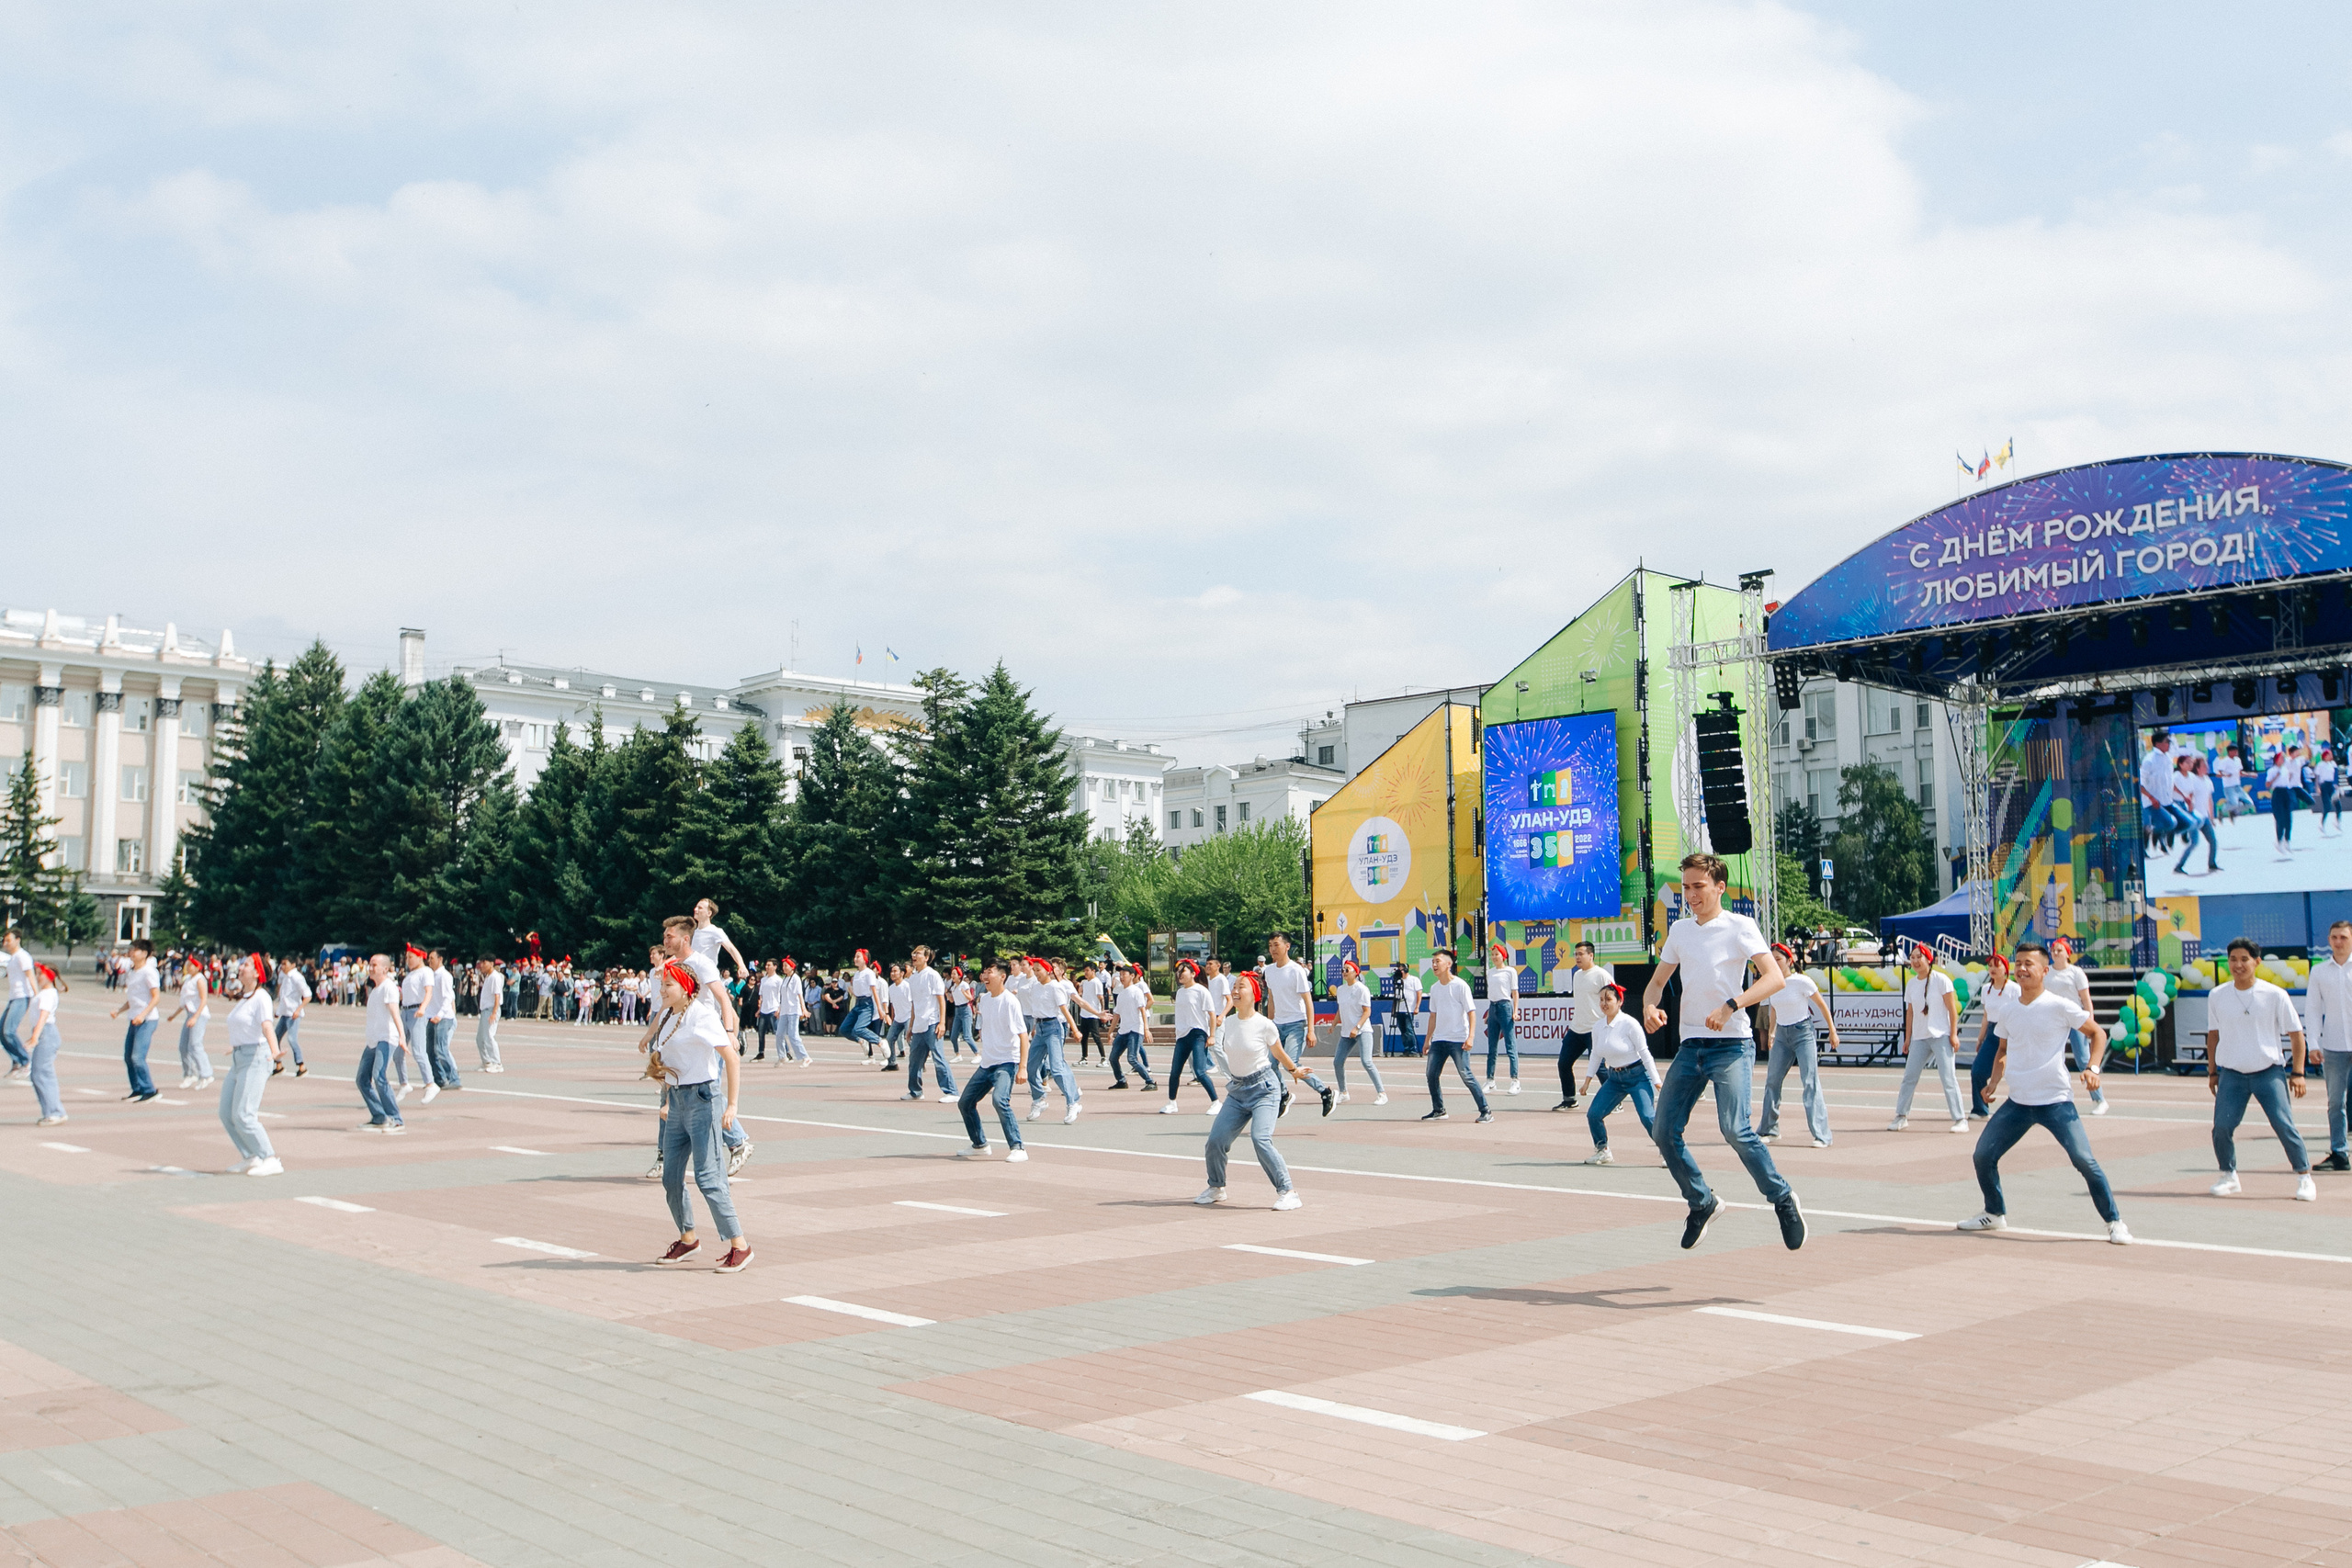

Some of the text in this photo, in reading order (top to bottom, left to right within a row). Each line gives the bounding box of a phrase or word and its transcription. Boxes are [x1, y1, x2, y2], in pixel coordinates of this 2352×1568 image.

[1909, 485, 2269, 569] С ДНЁМ РОЖДЕНИЯ,
[1920, 531, 2255, 608] ЛЮБИМЫЙ ГОРОД!
[1510, 807, 1592, 829] УЛАН-УДЭ
[1574, 833, 1592, 843] 2022
[1530, 834, 1574, 860] 356
[1358, 853, 1398, 865] УЛАН-УДЭ
[1515, 1007, 1575, 1021] ВЕРТОЛЕ
[1833, 1008, 1903, 1019] УЛАН-УДЭНС
[1515, 1024, 1569, 1040] РОССИИ
